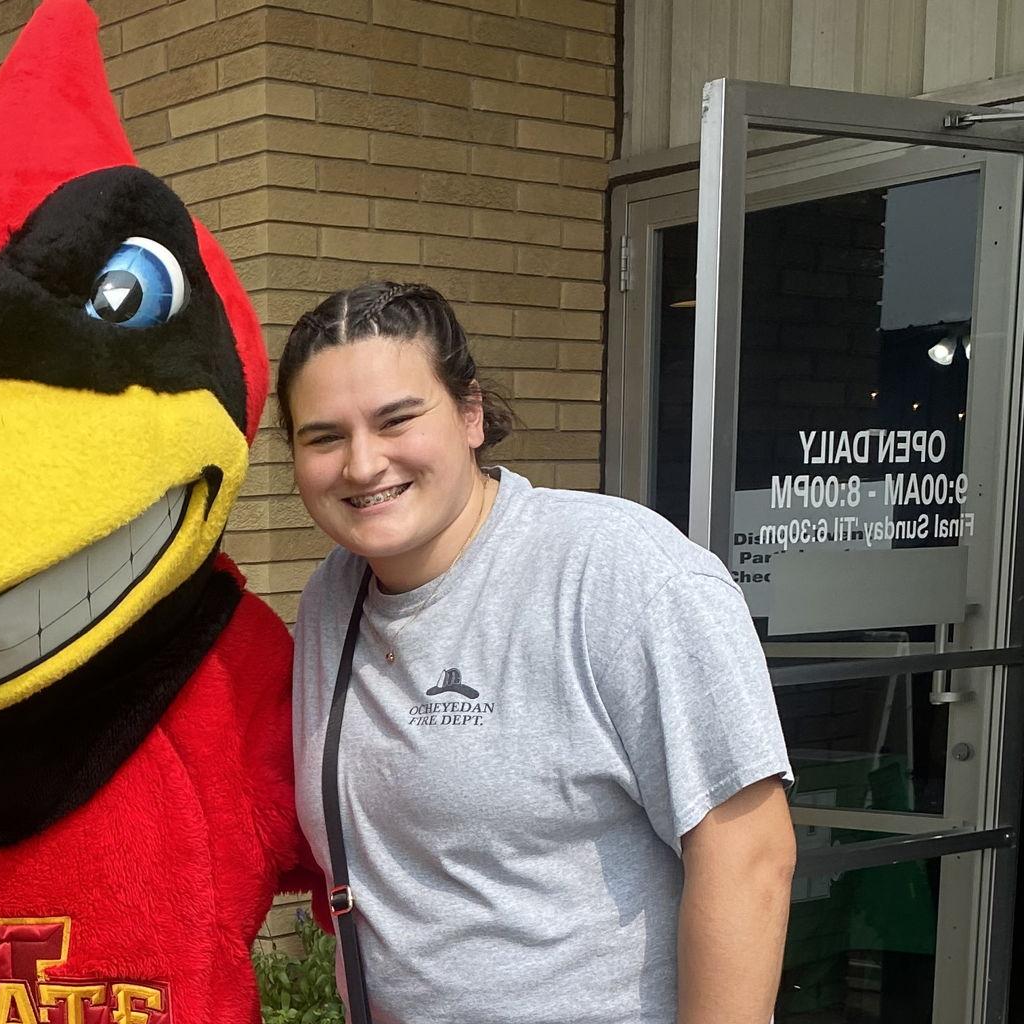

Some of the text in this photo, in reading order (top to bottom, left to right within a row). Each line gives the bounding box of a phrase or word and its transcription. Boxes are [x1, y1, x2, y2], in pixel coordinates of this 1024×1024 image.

[409, 702, 494, 715] OCHEYEDAN
[409, 714, 483, 726] FIRE DEPT.
